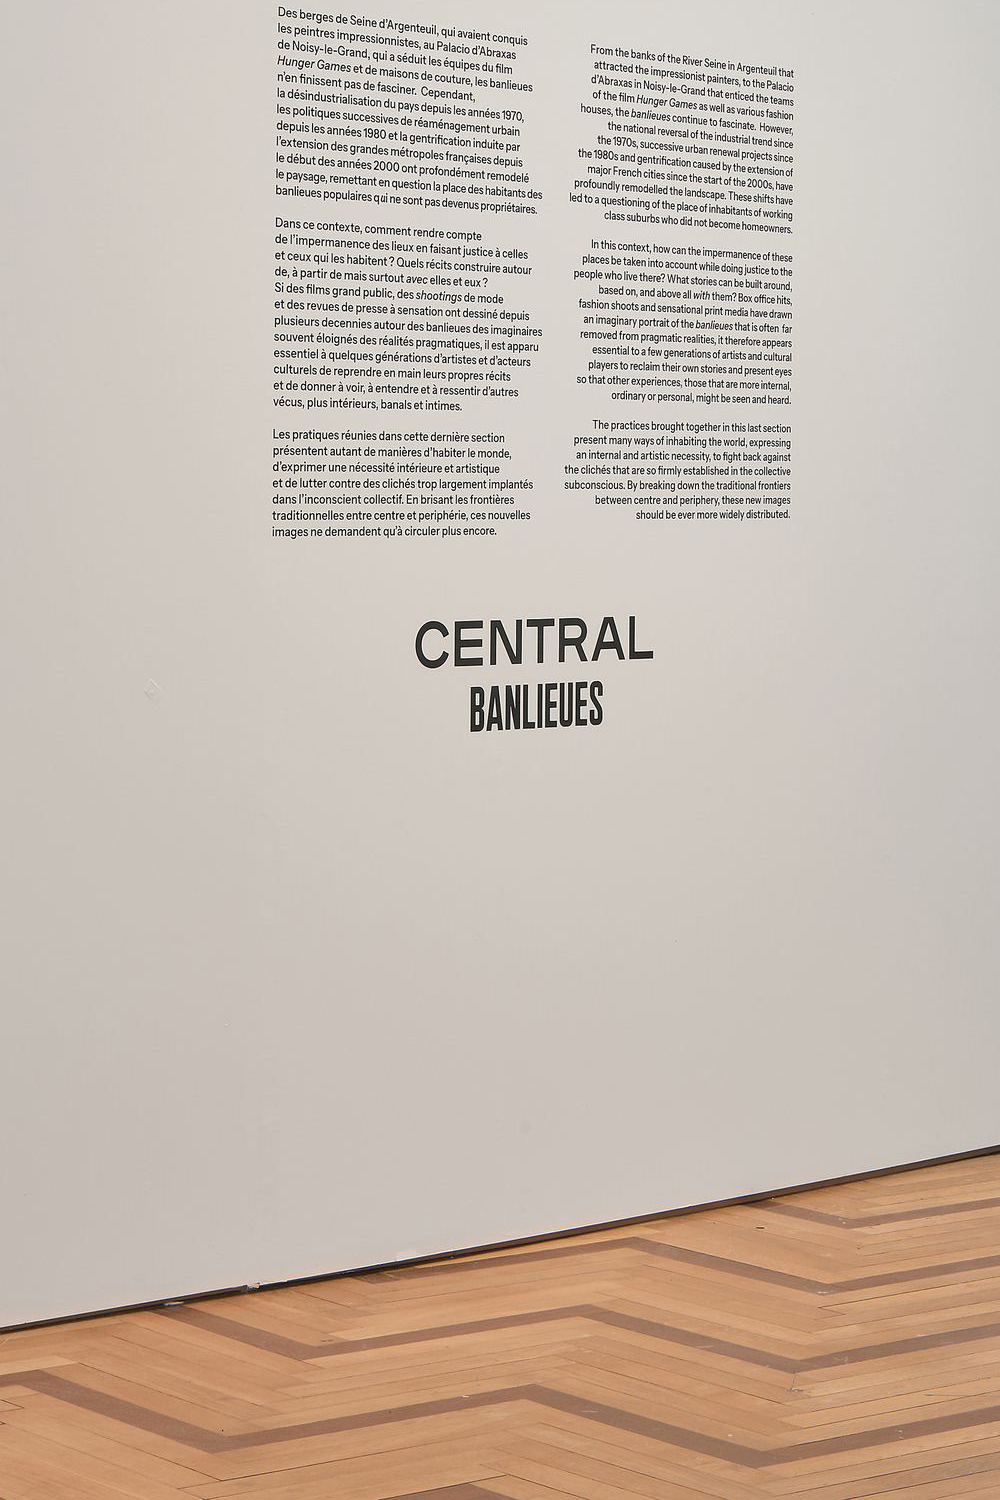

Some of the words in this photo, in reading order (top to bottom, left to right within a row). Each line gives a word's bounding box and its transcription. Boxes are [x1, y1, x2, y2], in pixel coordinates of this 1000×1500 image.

[277, 54, 316, 71] Hunger
[316, 59, 352, 73] Games
[353, 64, 363, 74] et
[364, 64, 378, 76] de
[379, 67, 420, 80] maisons
[420, 70, 433, 82] de
[434, 74, 473, 88] couture,
[475, 76, 488, 88] les
[489, 77, 533, 92] banlieues
[590, 43, 614, 56] From
[615, 47, 630, 58] the
[630, 48, 656, 62] banks
[657, 52, 666, 63] of
[667, 53, 681, 65] the
[682, 55, 703, 67] River
[704, 57, 727, 70] Seine
[727, 60, 735, 71] in
[736, 62, 777, 76] Argenteuil
[778, 67, 794, 78] that
[580, 102, 614, 118] houses,
[615, 106, 630, 118] the
[630, 108, 671, 122] banlieues
[672, 114, 708, 126] continue
[709, 117, 718, 127] to
[719, 117, 757, 131] fascinate.
[759, 122, 794, 136] However,
[276, 120, 310, 134] depuis
[311, 122, 326, 135] les
[326, 125, 362, 138] années
[363, 127, 387, 140] 1980
[388, 131, 398, 141] et
[399, 130, 408, 142] la
[409, 133, 472, 147] gentrification
[473, 137, 505, 151] induite
[505, 143, 521, 154] par
[276, 152, 285, 163] le
[286, 153, 316, 166] début
[317, 155, 336, 168] des
[337, 158, 372, 171] années
[373, 160, 400, 173] 2000
[401, 164, 418, 174] ont
[419, 165, 485, 180] profondément
[486, 172, 530, 184] remodelé
[577, 148, 593, 159] the
[593, 149, 619, 161] 1980s
[619, 153, 636, 163] and
[636, 155, 692, 168] gentrification
[692, 160, 721, 171] caused
[722, 161, 732, 174] by
[733, 162, 746, 173] the
[747, 165, 785, 177] extension
[785, 167, 794, 177] of
[574, 178, 621, 194] profoundly
[621, 183, 668, 195] remodelled
[669, 186, 684, 197] the
[684, 187, 727, 202] landscape.
[728, 190, 752, 203] These
[753, 193, 775, 205] shifts
[775, 194, 794, 206] have
[275, 217, 301, 229] Dans
[302, 221, 315, 230] ce
[316, 221, 363, 235] contexte,
[364, 225, 412, 237] comment
[413, 227, 445, 239] rendre
[445, 231, 482, 243] compte
[603, 210, 626, 221] class
[626, 212, 660, 224] suburbs
[661, 214, 679, 225] who
[679, 216, 693, 226] did
[694, 218, 708, 228] not
[708, 218, 741, 230] become
[741, 220, 793, 234] homeowners.
[274, 281, 284, 293] Si
[286, 282, 305, 294] des
[306, 283, 331, 296] films
[332, 286, 361, 299] grand
[363, 287, 395, 301] public,
[396, 288, 414, 300] des
[415, 289, 463, 305] shootings
[463, 292, 476, 303] de
[477, 293, 504, 304] mode
[598, 284, 624, 296] based
[625, 288, 638, 298] on,
[639, 287, 656, 297] and
[656, 288, 682, 299] above
[682, 289, 692, 300] all
[693, 290, 711, 301] with
[711, 291, 737, 302] them?
[738, 292, 753, 303] Box
[753, 293, 776, 305] office
[776, 295, 793, 307] hits,
[273, 333, 314, 343] souvent
[316, 332, 358, 347] éloignés
[359, 334, 377, 346] des
[378, 334, 414, 347] réalités
[415, 338, 483, 352] pragmatiques,
[484, 339, 490, 350] il
[491, 341, 506, 351] est
[507, 343, 539, 354] apparu
[272, 395, 305, 409] vécus,
[307, 397, 328, 410] plus
[329, 397, 379, 411] intérieurs,
[380, 398, 412, 410] banals
[413, 400, 424, 411] et
[425, 399, 463, 411] intimes.
[273, 428, 291, 440] Les
[292, 428, 340, 443] pratiques
[341, 429, 377, 441] réunies
[378, 430, 402, 442] dans
[403, 432, 429, 442] cette
[430, 431, 470, 443] dernière
[471, 432, 505, 443] section
[592, 419, 610, 430] The
[610, 420, 650, 432] practices
[651, 420, 684, 434] brought
[686, 422, 722, 434] together
[722, 422, 730, 432] in
[731, 422, 747, 433] this
[747, 422, 762, 433] last
[762, 423, 792, 433] section
[272, 478, 283, 489] et
[284, 477, 298, 489] de
[299, 477, 328, 489] lutter
[328, 478, 361, 489] contre
[362, 478, 381, 489] des
[381, 477, 416, 489] clichés
[417, 479, 438, 491] trop
[439, 478, 487, 492] largement
[488, 478, 534, 492] implantés
[635, 509, 664, 520] should
[665, 509, 677, 520] be
[677, 511, 696, 520] ever
[696, 511, 718, 520] more
[719, 509, 745, 522] widely
[745, 509, 791, 519] distributed.
[415, 616, 654, 669] CENTRAL
[470, 680, 604, 732] BANLIEUES
